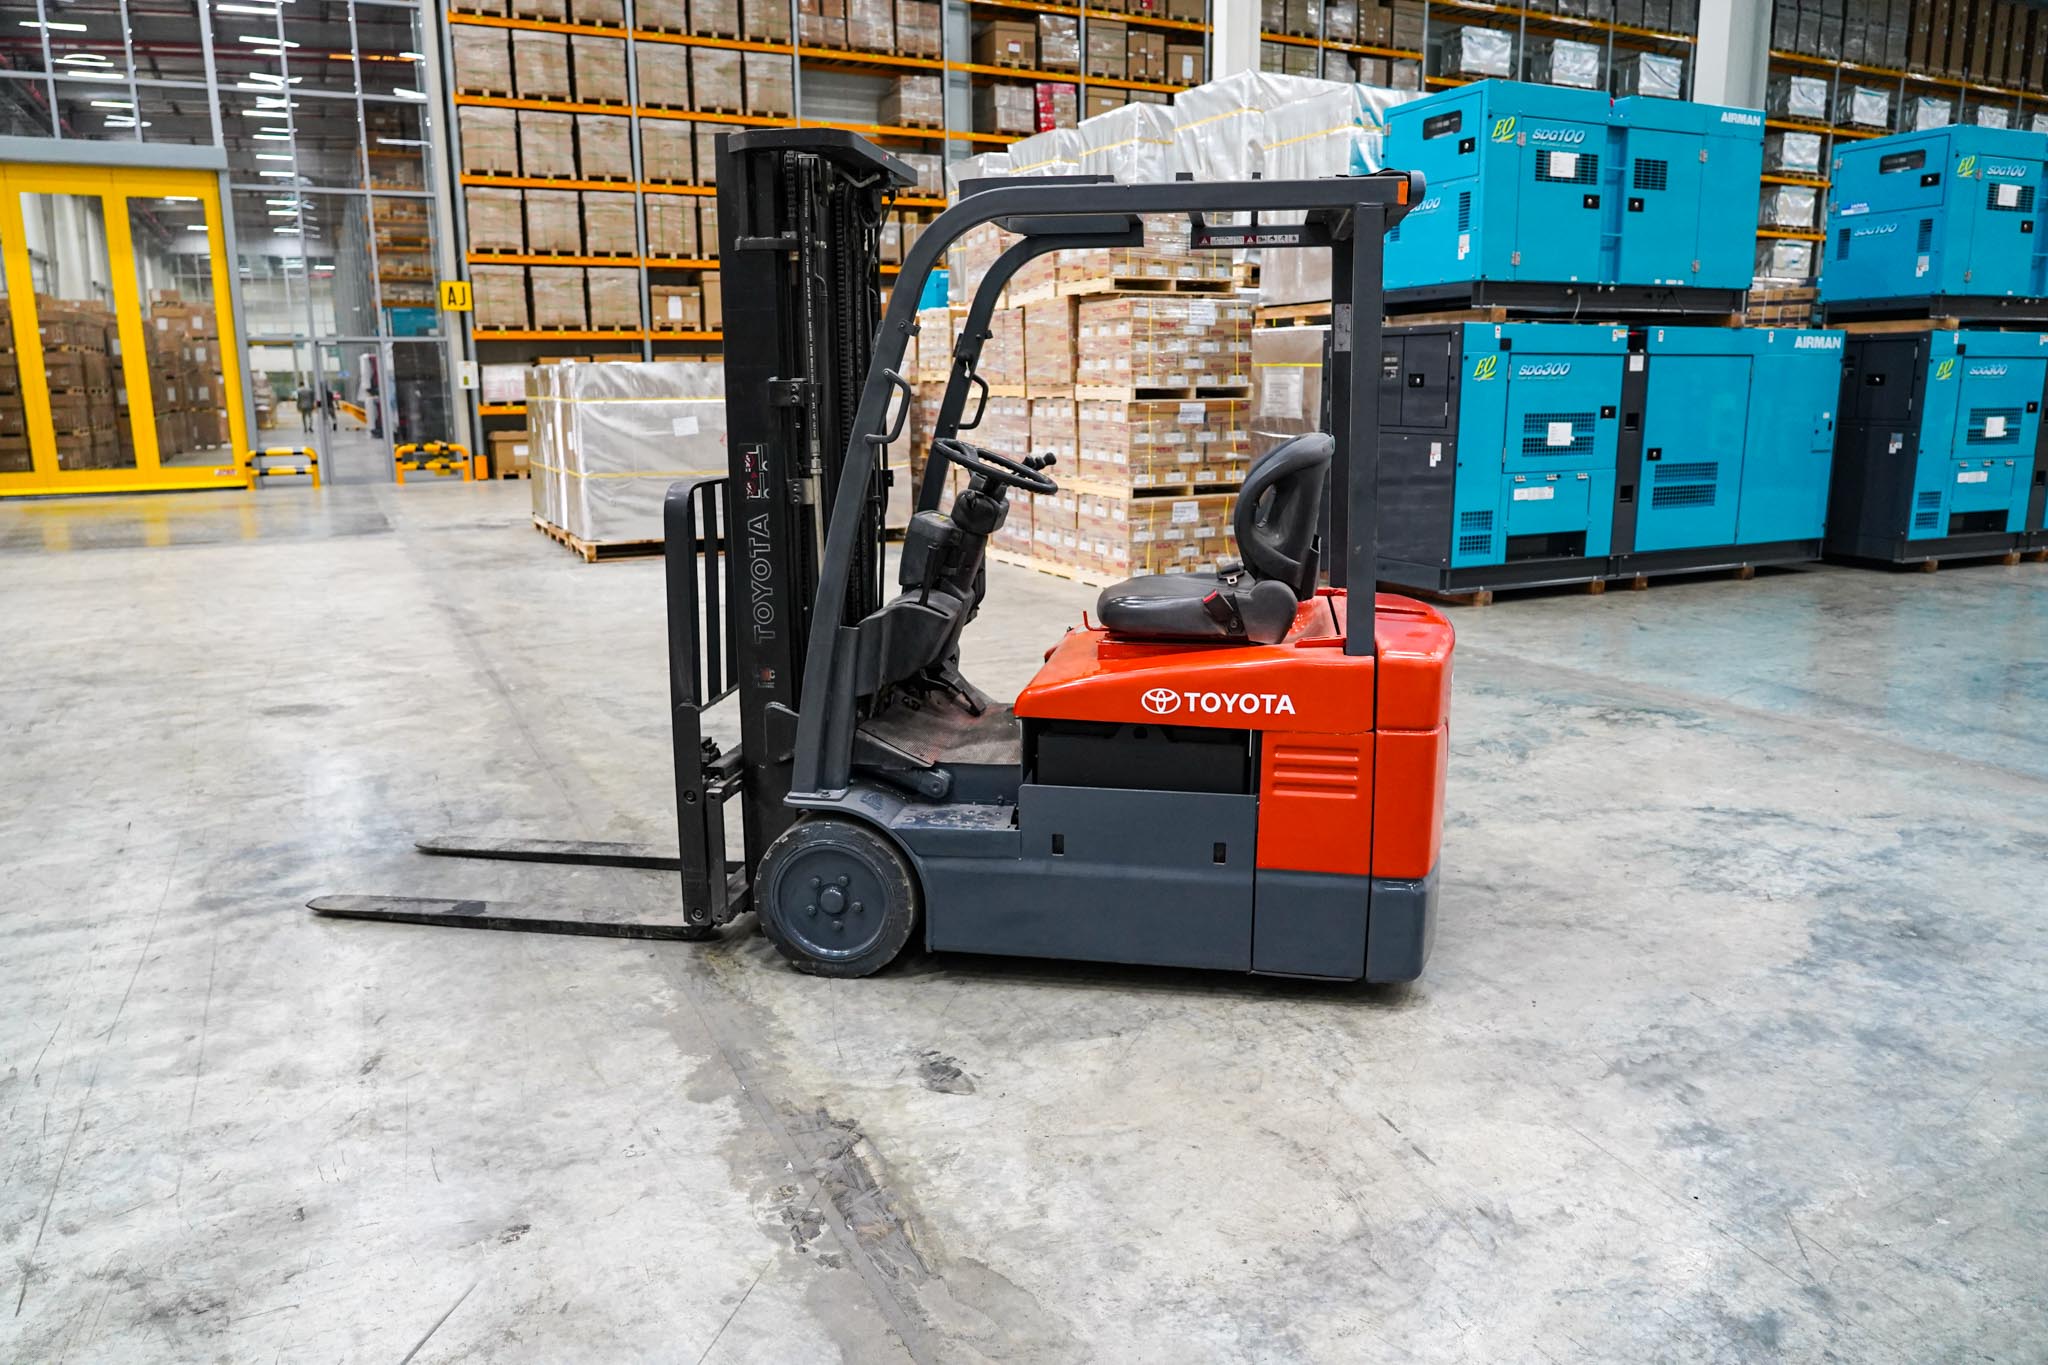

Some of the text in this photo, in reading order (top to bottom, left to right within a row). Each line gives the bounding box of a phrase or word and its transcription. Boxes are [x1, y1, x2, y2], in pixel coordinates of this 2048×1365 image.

[1721, 111, 1761, 126] AIRMAN
[1532, 128, 1585, 143] SDG100
[448, 286, 466, 306] AJ
[1794, 335, 1842, 349] AIRMAN
[1518, 362, 1571, 376] SDG300
[747, 512, 776, 644] TOYOTA
[1184, 692, 1296, 715] TOYOTA
